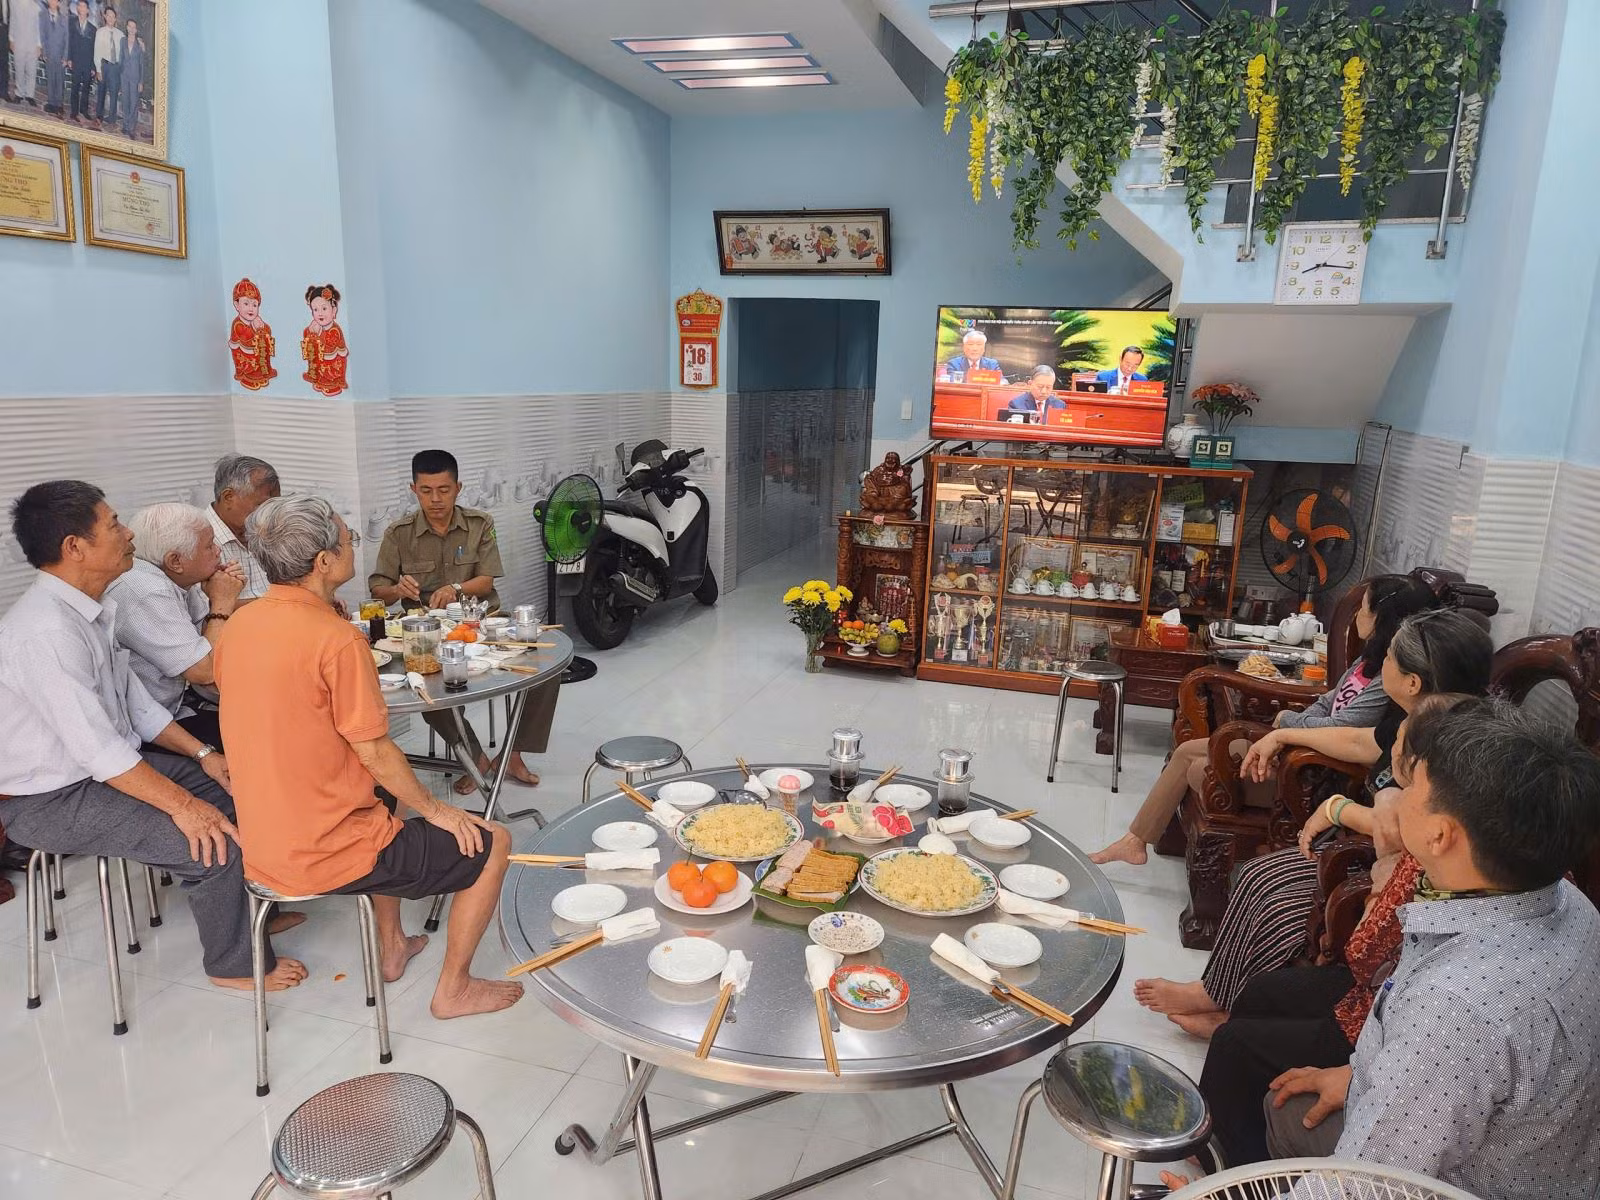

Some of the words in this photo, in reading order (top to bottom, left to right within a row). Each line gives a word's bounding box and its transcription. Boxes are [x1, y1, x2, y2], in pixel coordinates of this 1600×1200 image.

[1304, 235, 1312, 244] 11
[1319, 235, 1332, 244] 12
[1341, 235, 1346, 244] 1
[1292, 246, 1305, 255] 10
[1347, 245, 1357, 254] 2
[1290, 261, 1299, 271] 9
[1346, 261, 1354, 269] 3
[1288, 277, 1297, 286] 8
[1342, 277, 1351, 285] 4
[1297, 287, 1306, 296] 7
[1313, 287, 1322, 296] 6
[1330, 286, 1340, 296] 5
[690, 347, 706, 365] 18
[692, 372, 703, 381] 30
